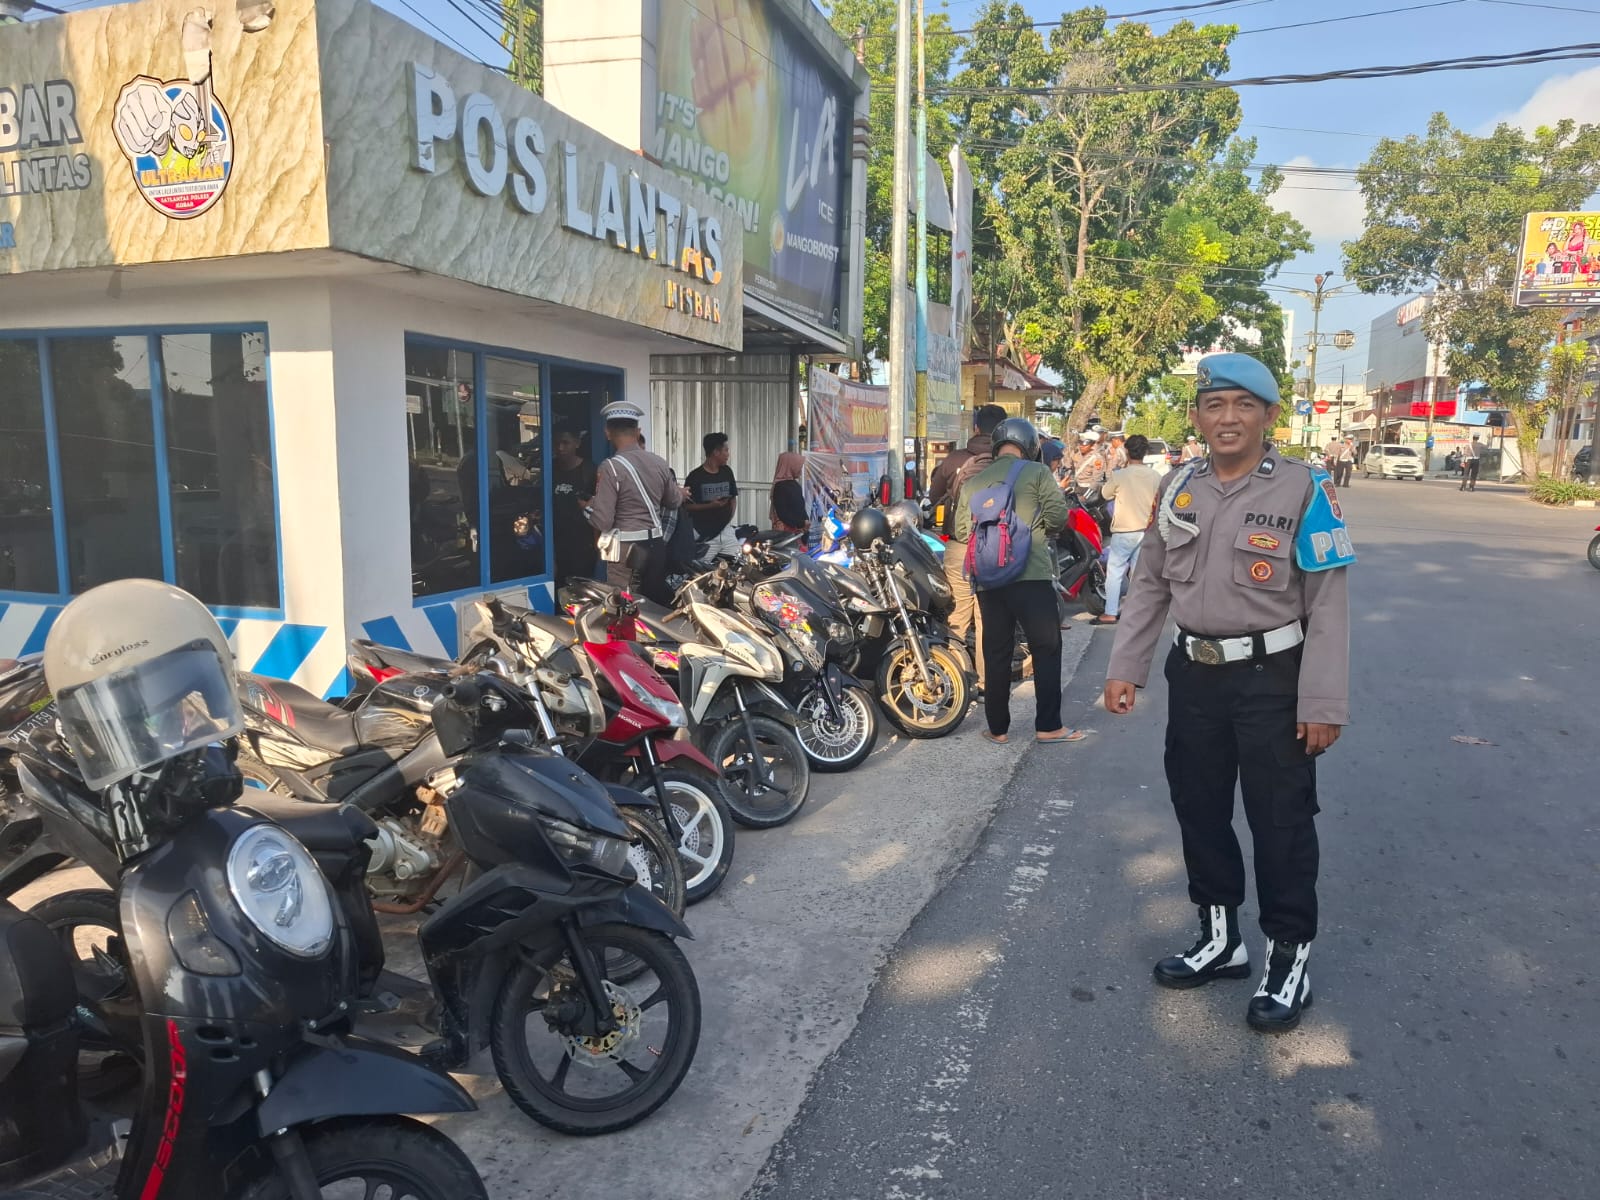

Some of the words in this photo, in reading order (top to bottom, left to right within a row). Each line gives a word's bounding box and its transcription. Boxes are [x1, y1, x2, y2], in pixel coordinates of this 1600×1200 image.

[656, 91, 698, 130] IT'S
[407, 61, 546, 215] POS
[562, 141, 723, 285] LANTAS
[819, 199, 834, 225] ICE
[786, 231, 840, 264] MANGOBOOST
[1244, 512, 1294, 531] POLRI
